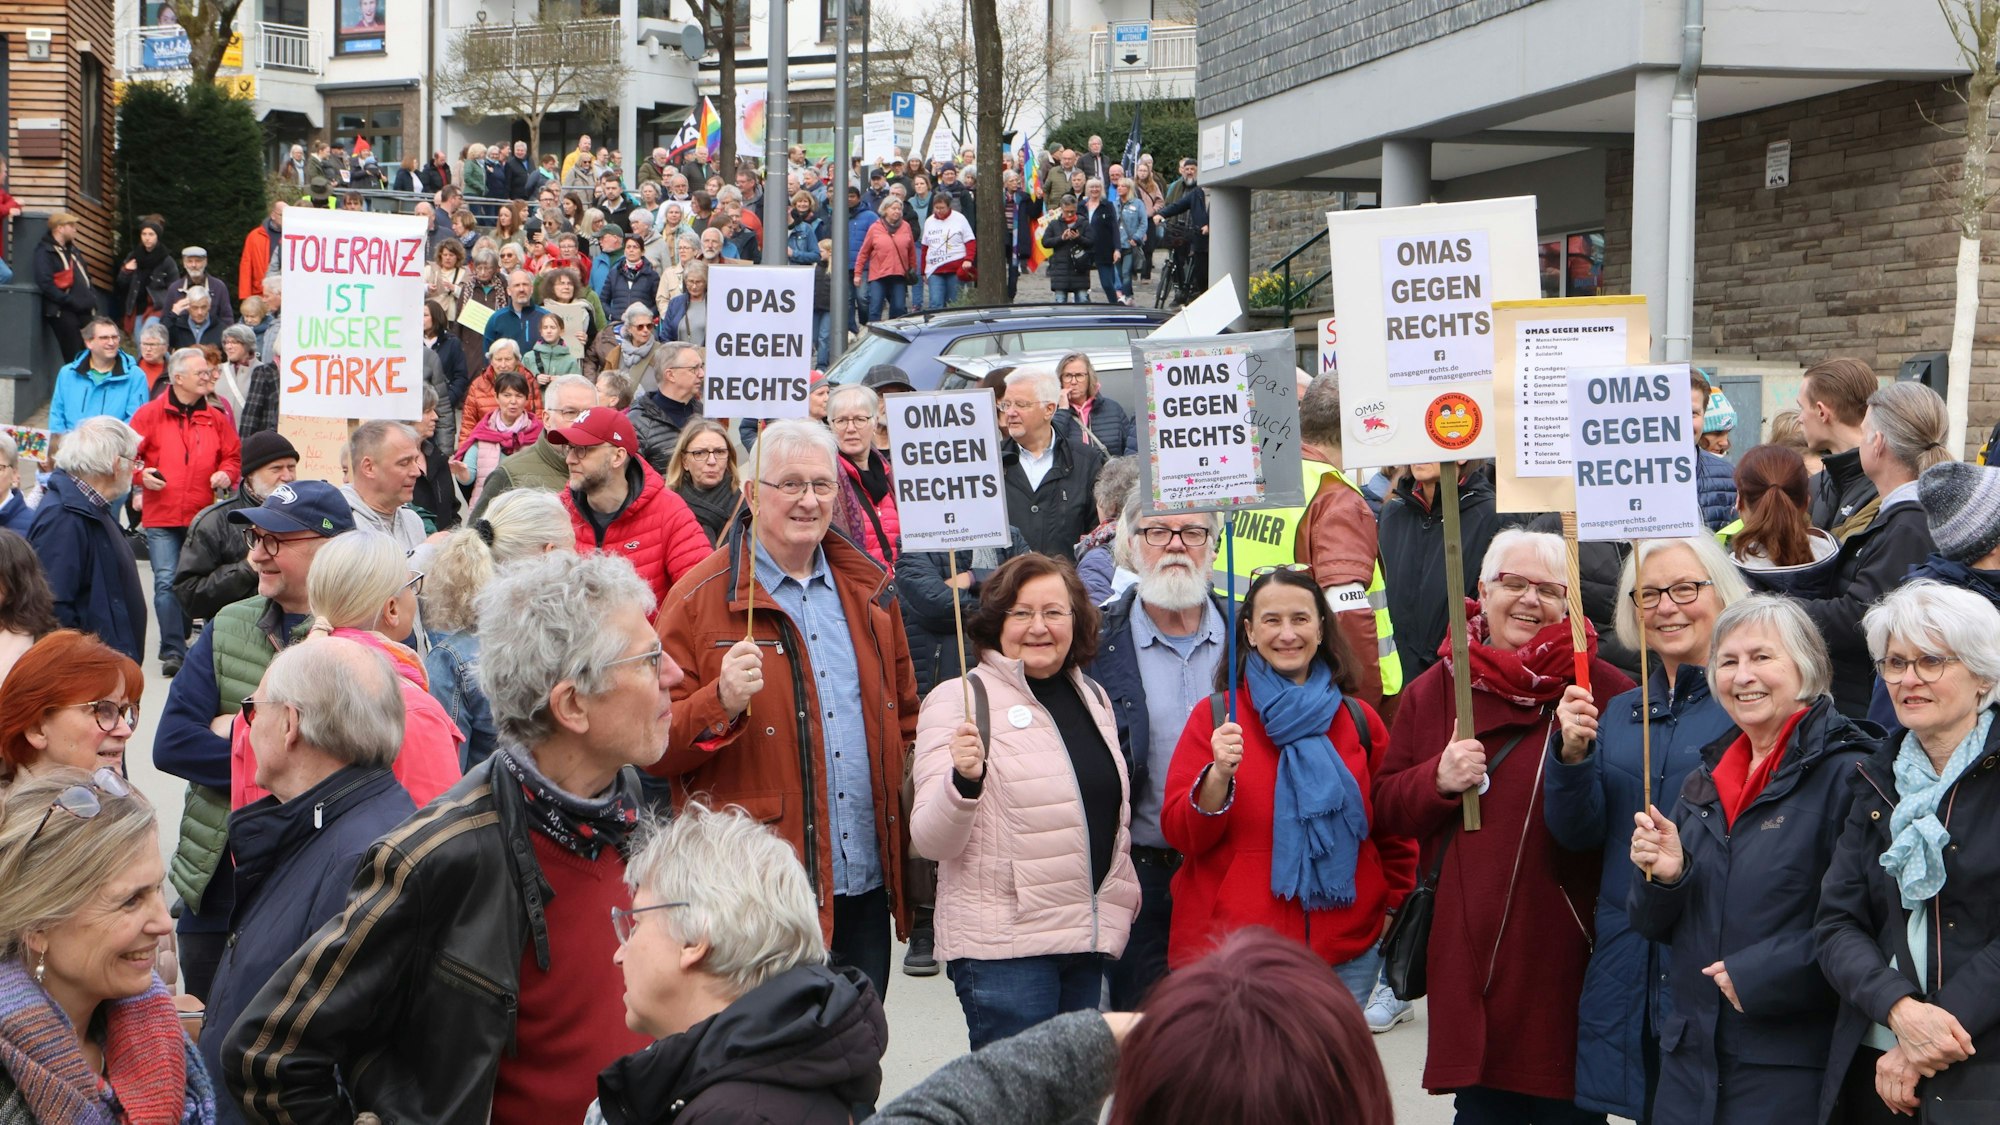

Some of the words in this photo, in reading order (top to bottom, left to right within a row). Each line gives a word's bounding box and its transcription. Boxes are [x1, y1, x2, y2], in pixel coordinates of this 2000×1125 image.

[36, 45, 43, 55] 3
[896, 95, 910, 115] P
[284, 234, 422, 277] TOLERANZ
[1397, 238, 1472, 266] OMAS
[327, 283, 375, 313] IST
[727, 288, 796, 313] OPAS
[1391, 274, 1481, 304] GEGEN
[297, 316, 403, 349] UNSERE
[1386, 310, 1491, 341] RECHTS
[715, 333, 803, 357] GEGEN
[287, 354, 408, 397] STÄRKE
[1167, 363, 1230, 386] OMAS
[1389, 364, 1459, 378] omasgegenrechts.de
[1428, 369, 1492, 382] #omasgegenrechts
[708, 377, 808, 402] RECHTS
[1587, 375, 1671, 405] OMAS
[904, 402, 976, 429] OMAS
[1163, 394, 1238, 418] GEGEN
[1354, 402, 1385, 416] OMAS
[1159, 424, 1246, 449] RECHTS
[1243, 409, 1292, 440] auch
[1582, 416, 1681, 446] GEGEN
[901, 438, 987, 466] GEGEN
[1162, 469, 1220, 481] omasgegenrechts.de
[1194, 473, 1248, 484] #omasgegenrechts
[1577, 456, 1692, 487] RECHTS
[898, 474, 998, 502] RECHTS
[904, 527, 970, 540] omasgegenrechts.de
[1231, 510, 1286, 546] RDNER
[1580, 516, 1657, 529] omasgegenrechts.de
[1623, 521, 1694, 534] #omasgegenrechts
[940, 531, 1002, 544] #omasgegenrechts
